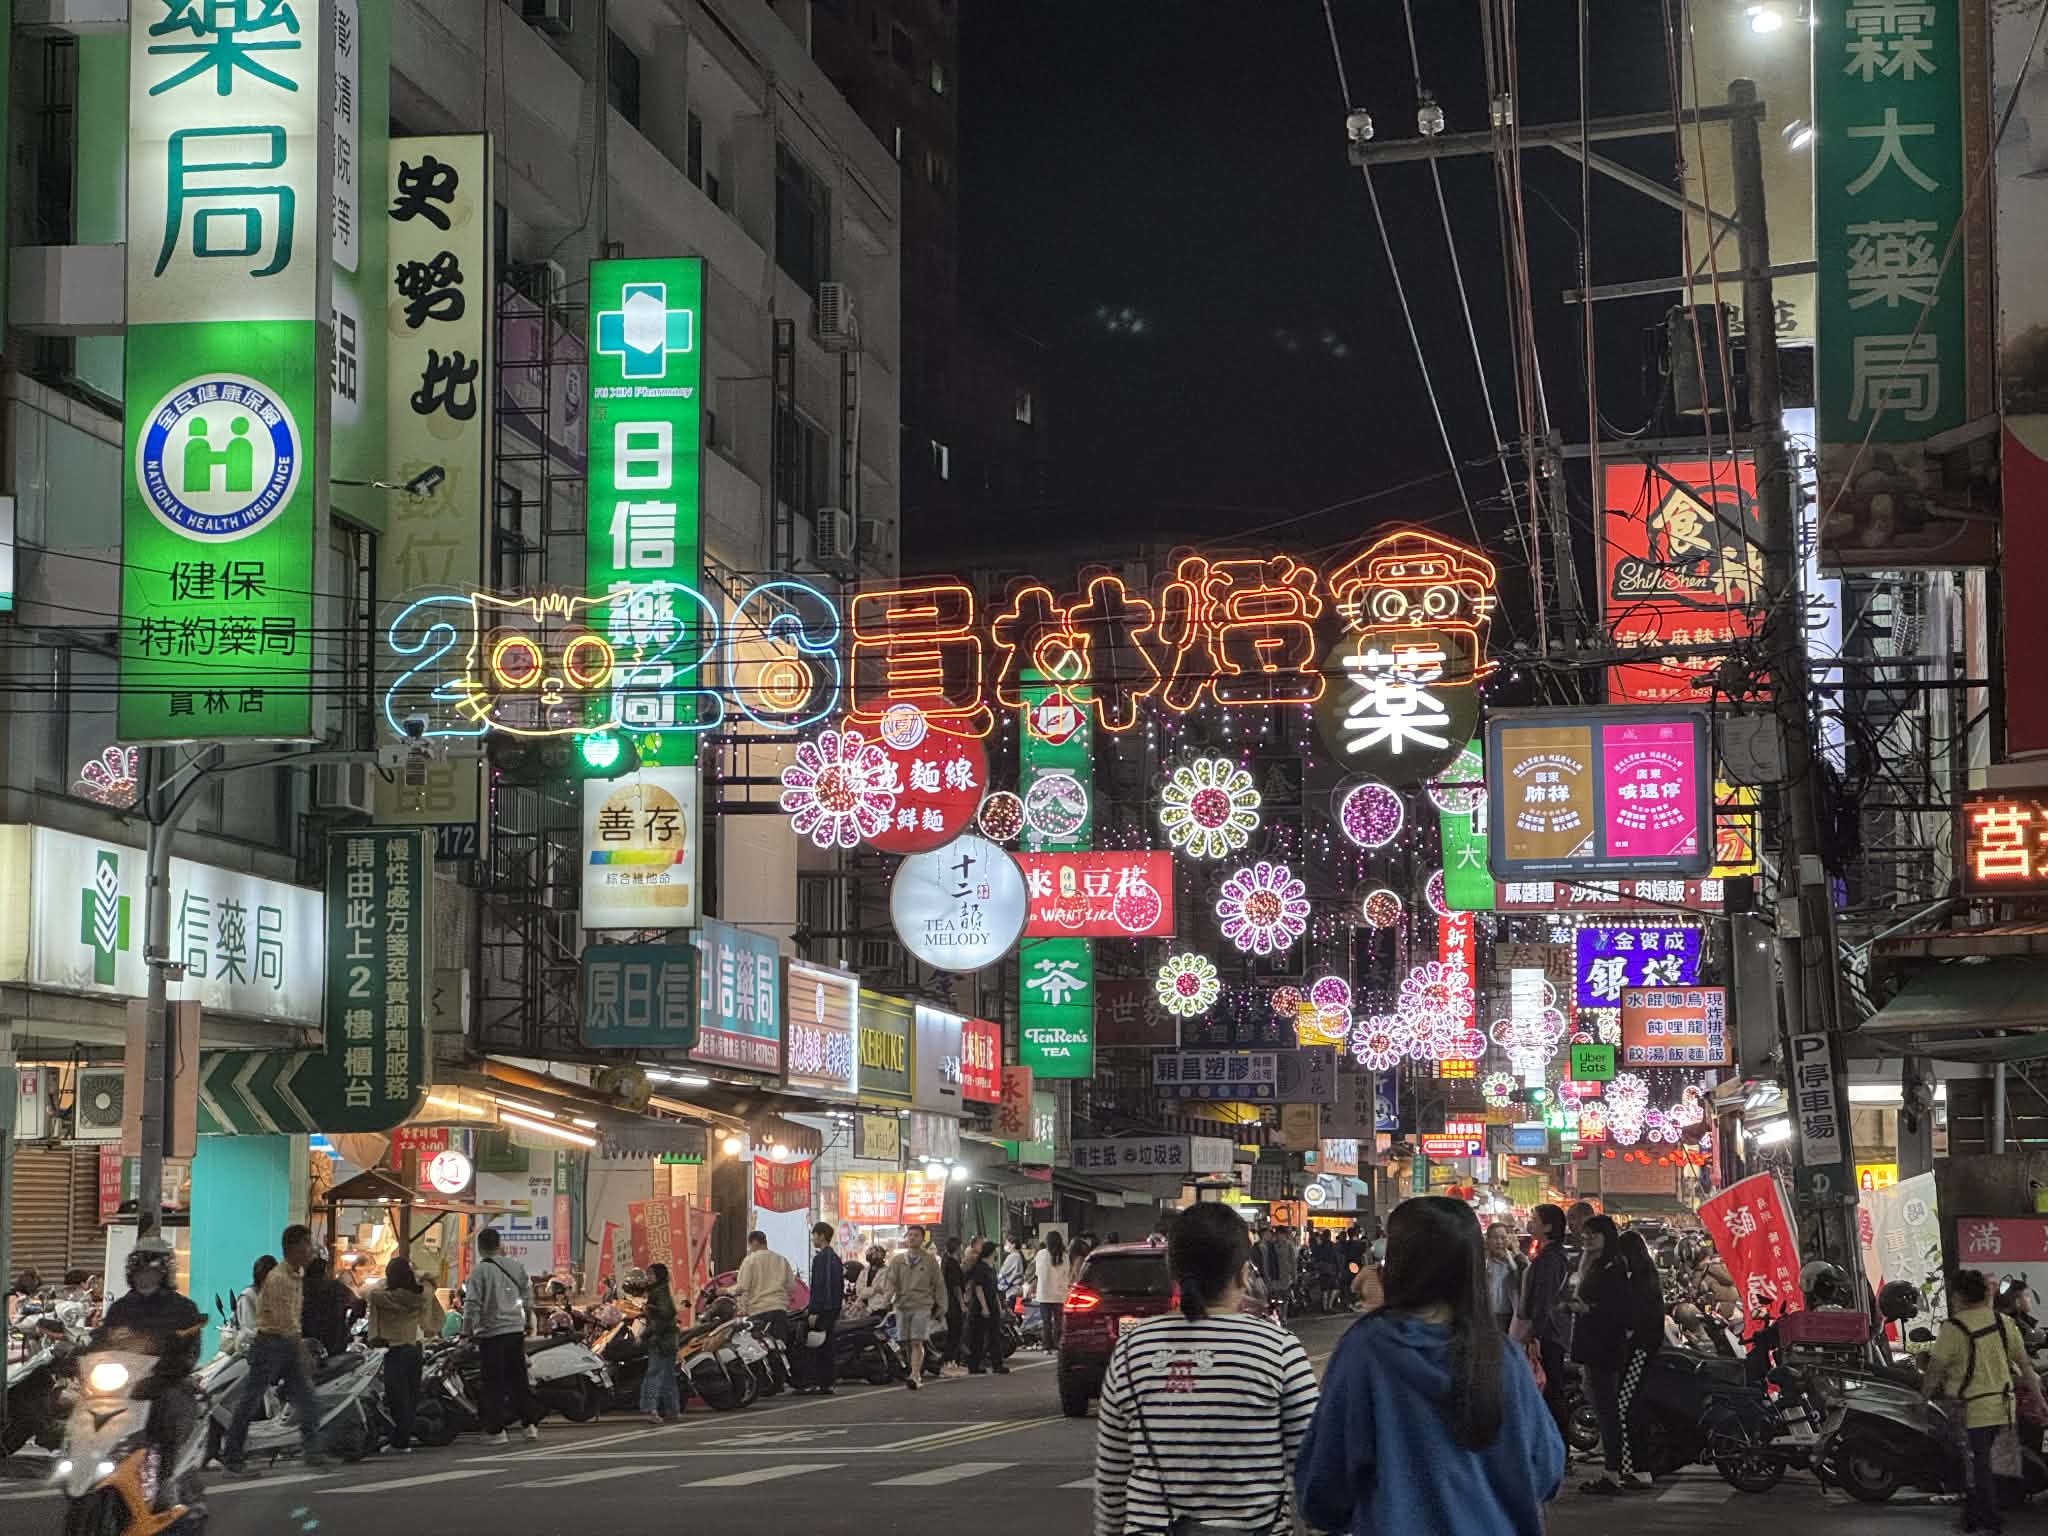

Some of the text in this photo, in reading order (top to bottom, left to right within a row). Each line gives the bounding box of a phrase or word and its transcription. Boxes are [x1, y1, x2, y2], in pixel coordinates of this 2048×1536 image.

[157, 384, 283, 432] 全民健康保險
[147, 456, 291, 531] NATIONAL HEALTH INSURANCE
[169, 561, 266, 601] 健保
[608, 420, 677, 730] 日信藥局
[139, 616, 296, 657] 特約藥局
[168, 688, 264, 718] 員林店
[598, 805, 681, 842] 善存
[1635, 880, 1686, 902] 肉燥飯
[924, 918, 956, 932] TEA
[924, 932, 990, 946] MELODY
[1614, 932, 1686, 951] 金賀成
[344, 838, 375, 1108] 請由此上2樓櫃台
[1025, 958, 1089, 1007] 茶
[585, 960, 692, 1031] 原日信
[1706, 992, 1724, 1062] 現炸排骨飯
[860, 1027, 905, 1072] KEBUKE
[1040, 1047, 1071, 1057] TEA
[1579, 1052, 1606, 1063] Uber
[1580, 1062, 1607, 1074] Eats
[1139, 1143, 1183, 1166] 垃圾袋
